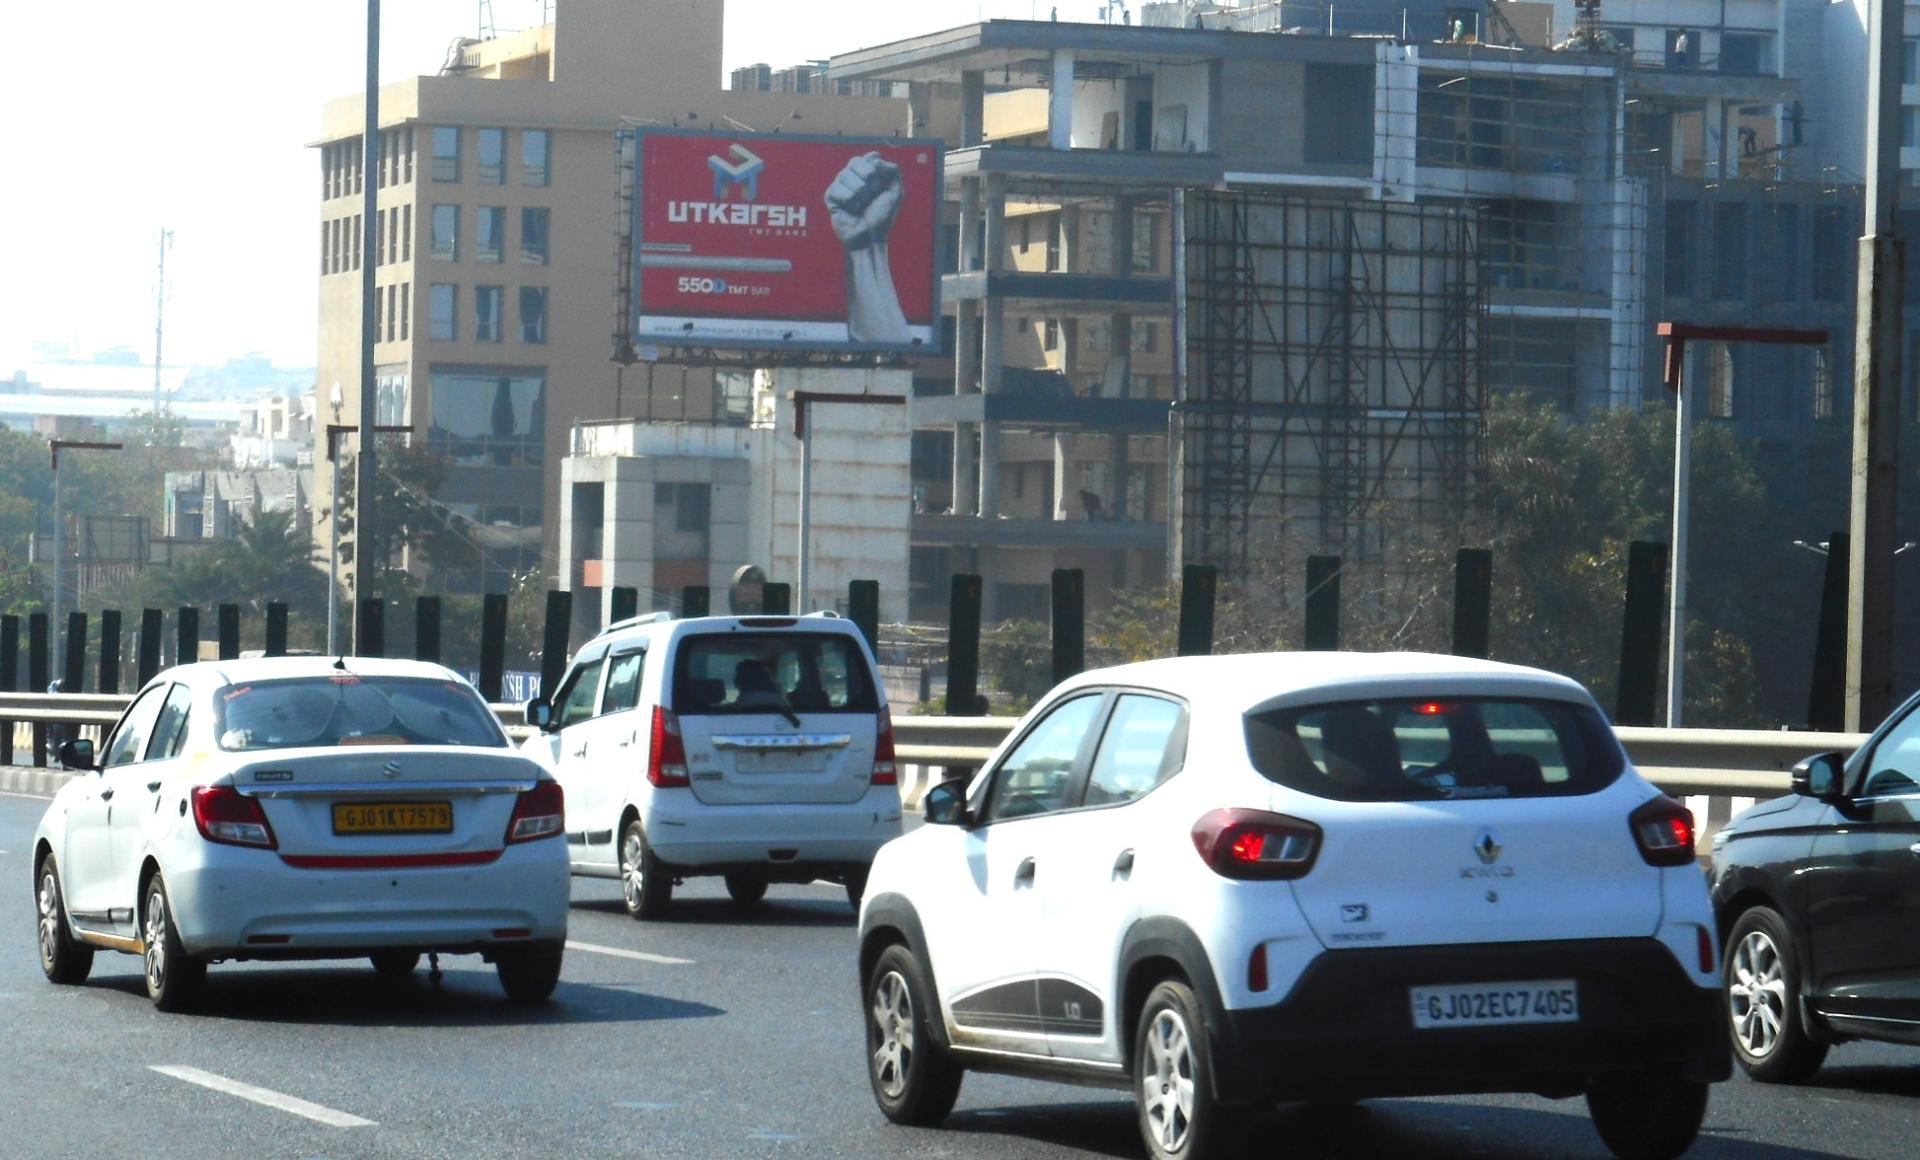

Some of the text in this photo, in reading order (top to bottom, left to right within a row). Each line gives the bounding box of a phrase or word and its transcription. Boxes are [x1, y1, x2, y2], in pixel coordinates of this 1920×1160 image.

[677, 276, 771, 296] 550D TMT BAR
[345, 806, 449, 827] GJ01KT7579
[1427, 989, 1576, 1021] GJ02EC7405
